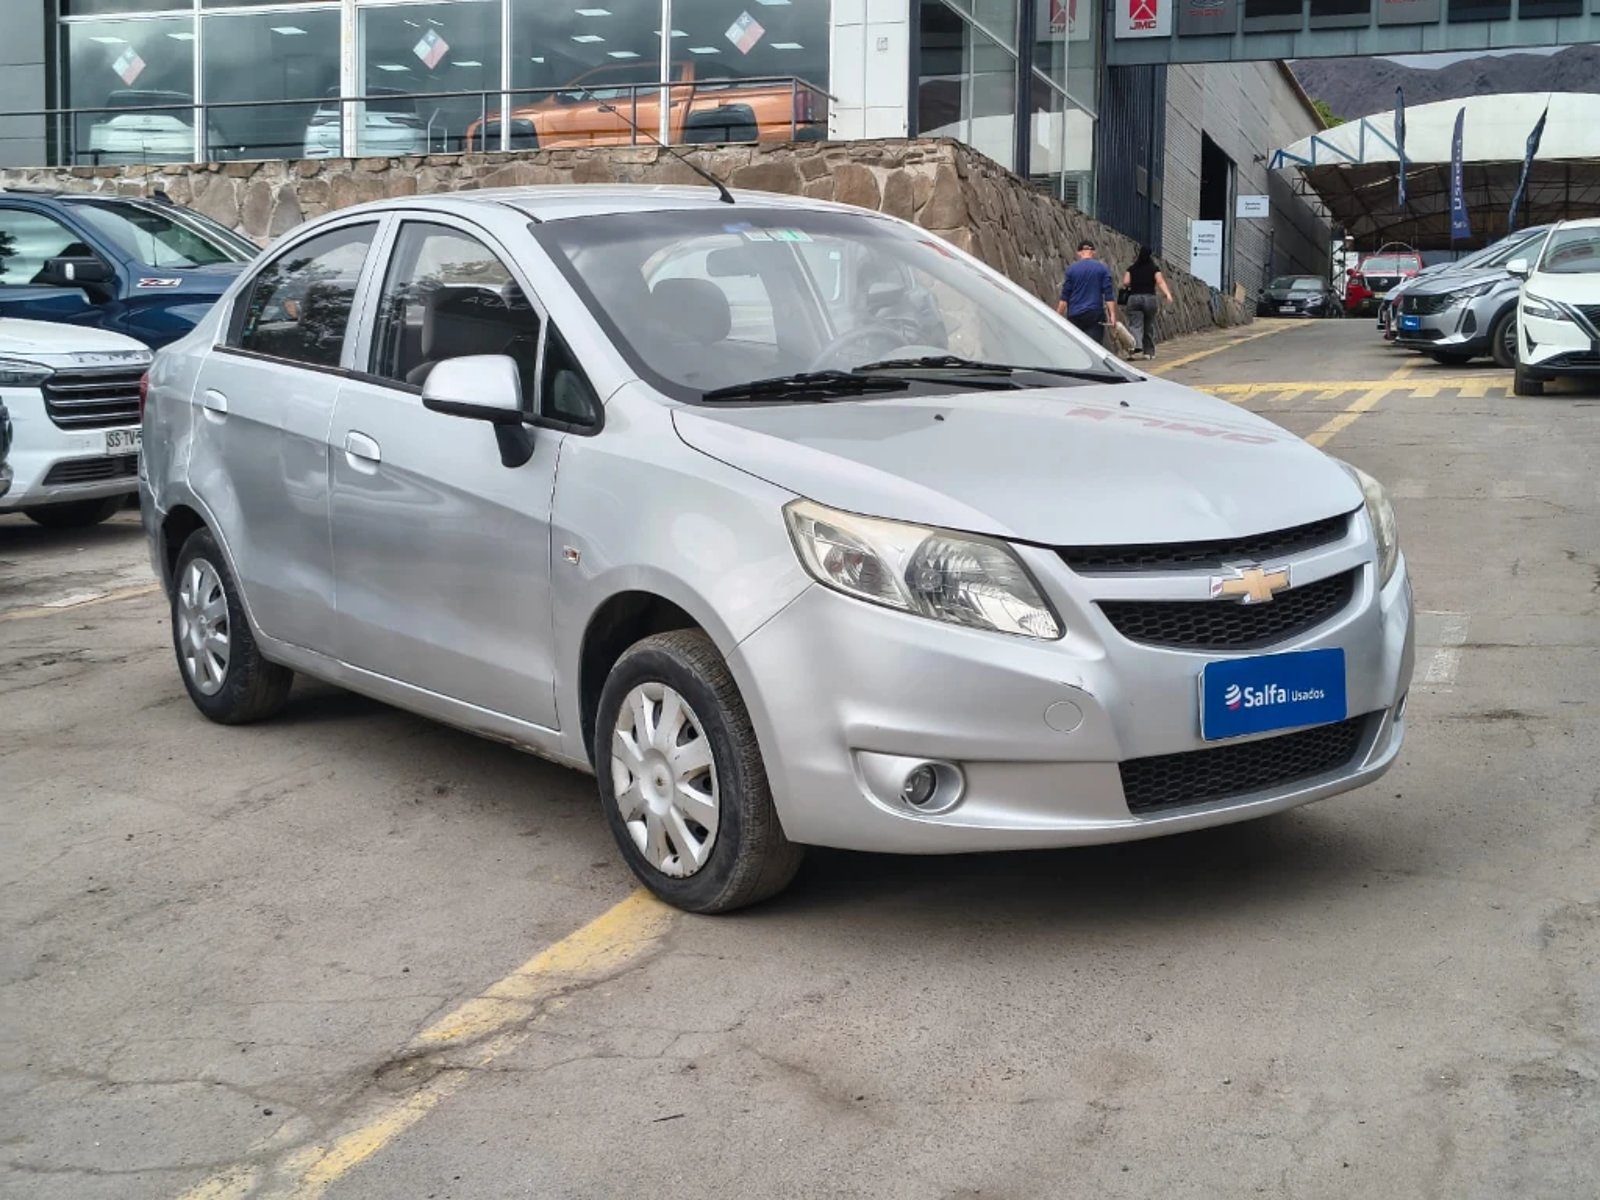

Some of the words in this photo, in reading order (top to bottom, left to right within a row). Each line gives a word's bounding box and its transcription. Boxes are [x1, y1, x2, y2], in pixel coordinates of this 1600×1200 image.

[1129, 20, 1157, 30] JMC
[1243, 684, 1287, 708] Salfa
[1291, 689, 1325, 702] Usados
